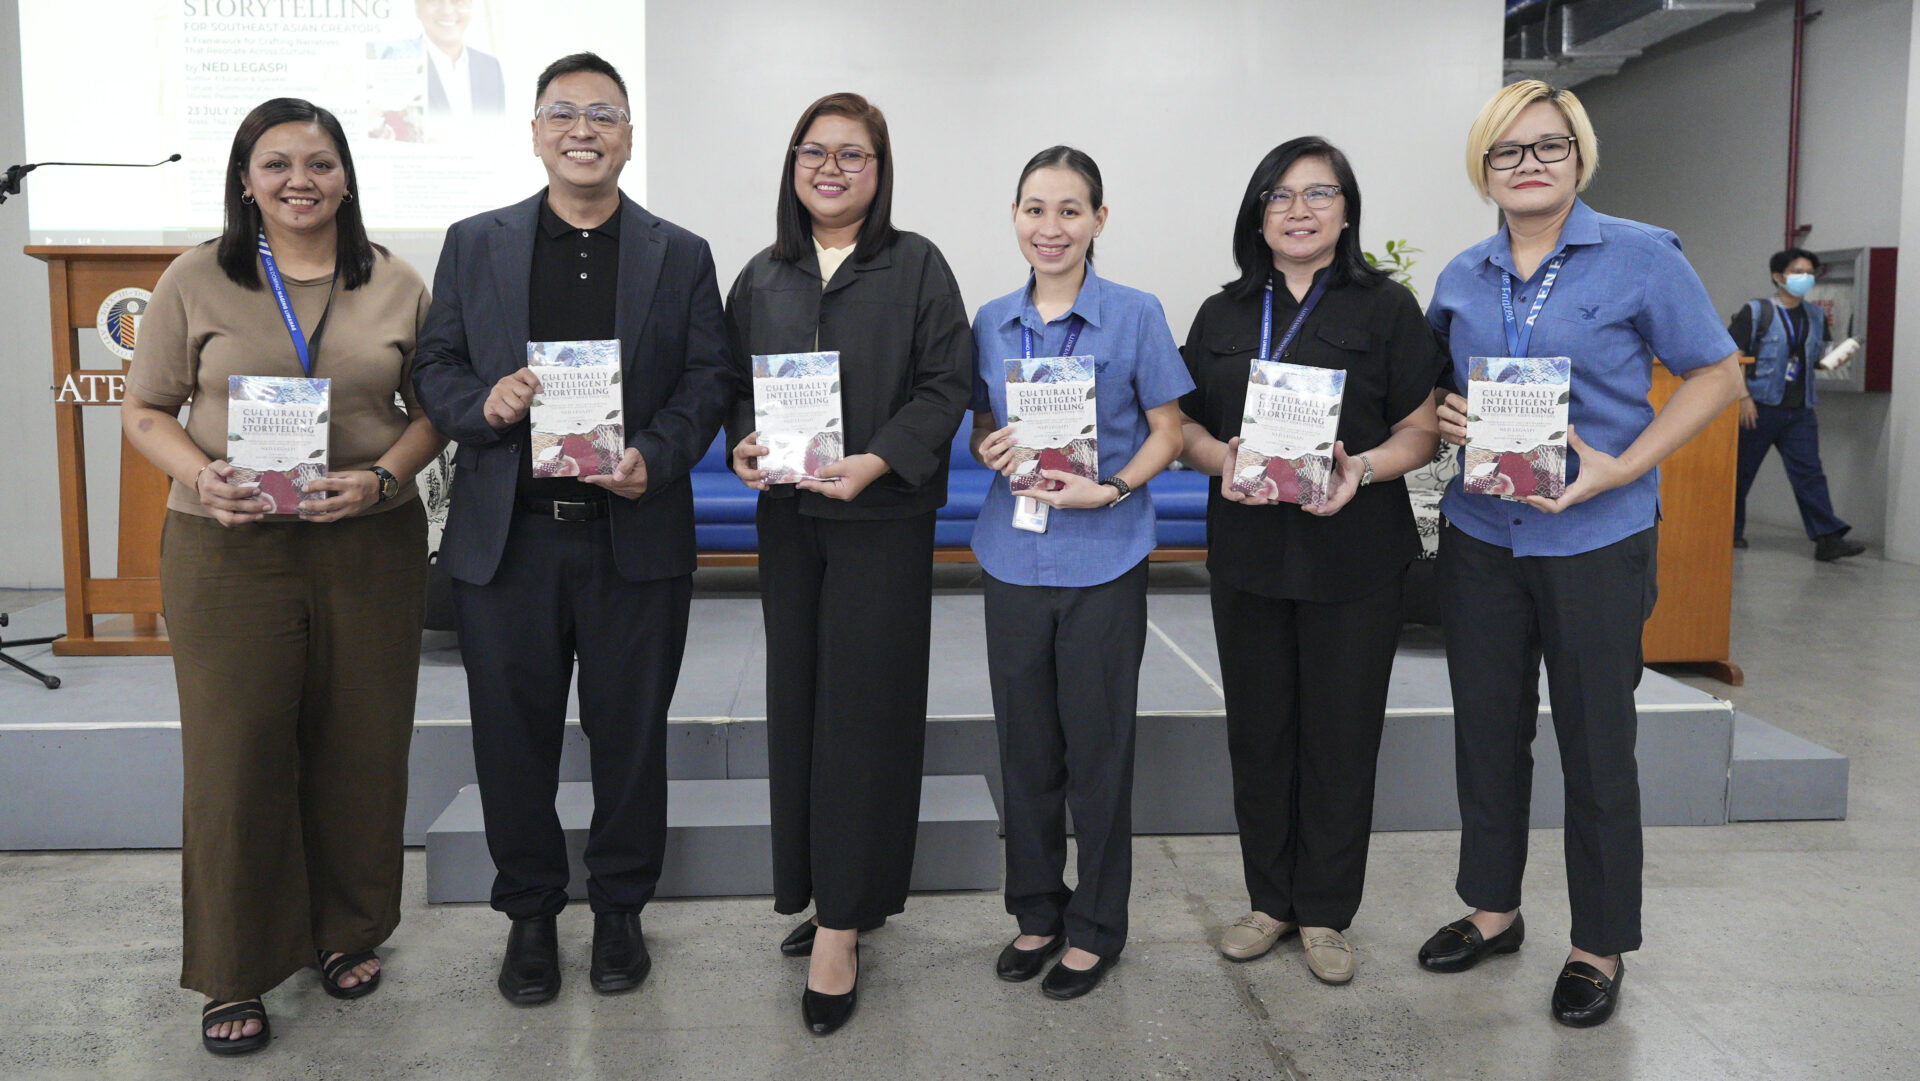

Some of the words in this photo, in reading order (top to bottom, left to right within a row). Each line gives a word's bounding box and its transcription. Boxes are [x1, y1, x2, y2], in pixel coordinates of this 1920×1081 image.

[183, 0, 391, 20] STORYTELLING
[184, 22, 207, 32] FOR
[211, 23, 279, 33] SOUTHEAST
[282, 24, 318, 33] ASIAN
[321, 24, 382, 34] CREATORS
[185, 46, 204, 55] That
[185, 64, 198, 74] by
[201, 62, 230, 73] NED
[234, 63, 288, 73] LEGASPI
[188, 105, 200, 116] 23
[203, 105, 229, 116] JULY
[542, 371, 609, 382] CULTURALLY
[542, 380, 608, 390] INTELLIGENT
[766, 382, 829, 391] CULTURALLY
[542, 388, 609, 397] STORYTELLING
[766, 389, 828, 400] INTELLIGENT
[1019, 387, 1084, 398] CULTURALLY
[1481, 389, 1556, 398] CULTURALLY
[1020, 395, 1083, 405] INTELLIGENT
[1482, 397, 1555, 406] INTELLIGENT
[1020, 403, 1085, 412] STORYTELLING
[1481, 405, 1555, 415] STORYTELLING
[242, 408, 315, 418] CULTURALLY
[1256, 408, 1325, 425] STORYTELLING
[243, 416, 315, 426] INTELLIGENT
[242, 424, 315, 434] STORYTELLING
